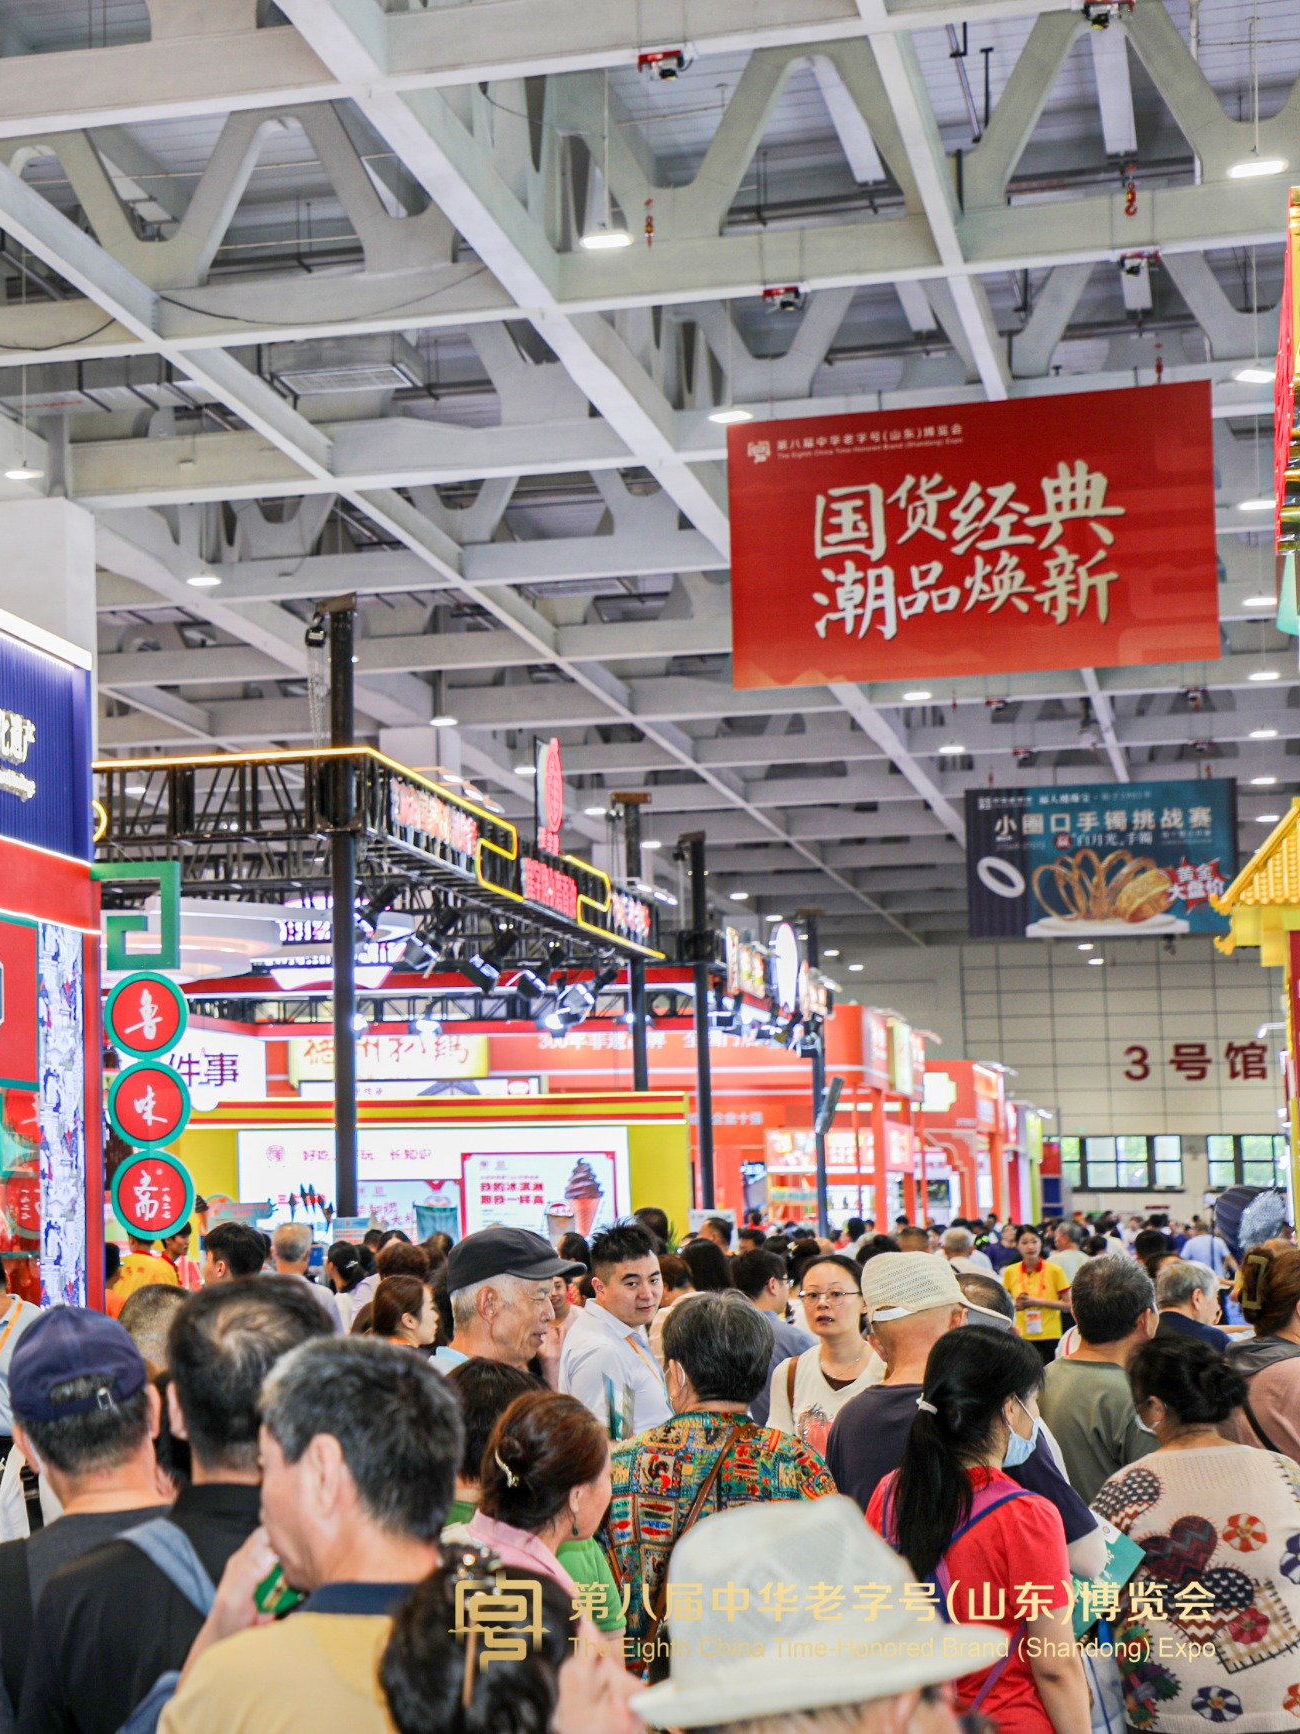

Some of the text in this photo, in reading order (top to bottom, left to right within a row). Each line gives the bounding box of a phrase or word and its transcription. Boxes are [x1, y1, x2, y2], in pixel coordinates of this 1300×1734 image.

[813, 458, 1126, 562] 国货经典
[812, 544, 1120, 641] 潮品焕新
[1123, 1041, 1269, 1082] 3号馆
